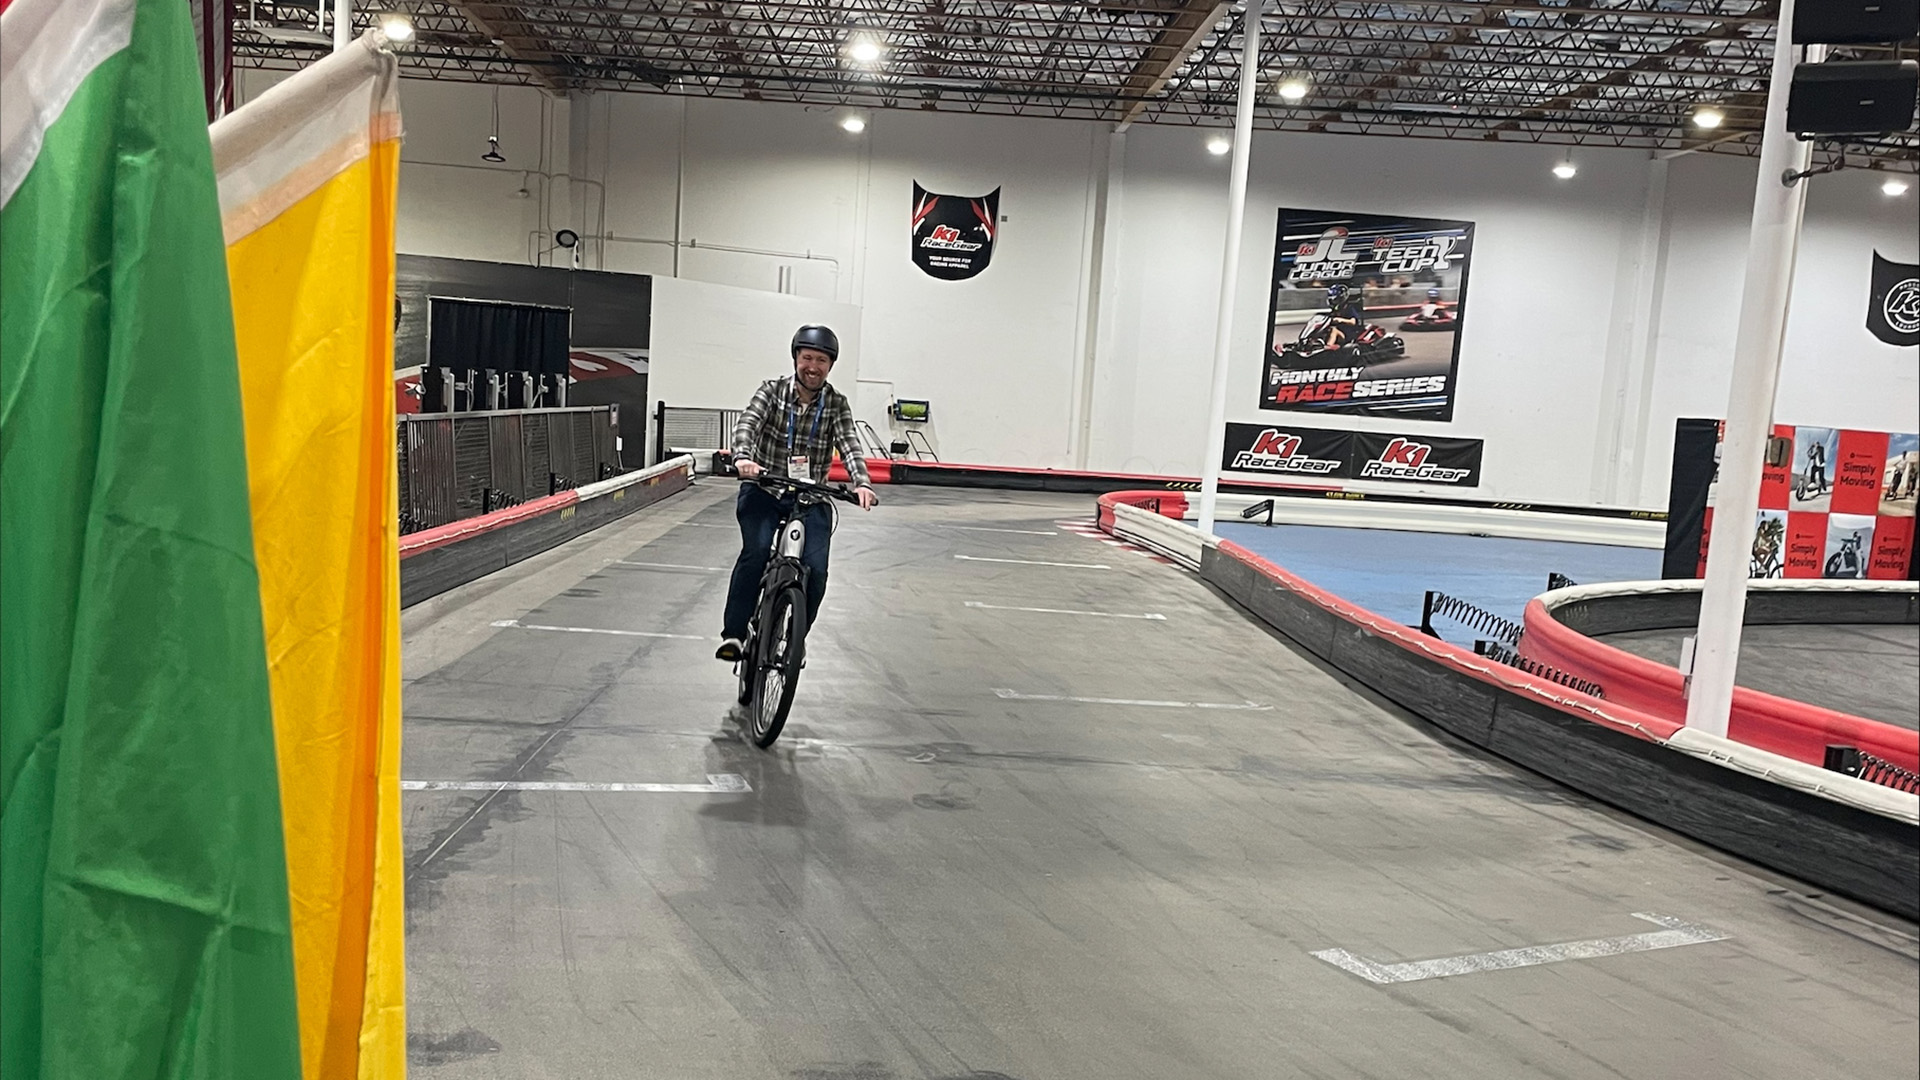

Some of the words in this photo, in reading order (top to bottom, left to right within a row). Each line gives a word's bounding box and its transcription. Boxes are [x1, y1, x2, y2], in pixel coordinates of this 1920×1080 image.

[932, 226, 960, 243] K1
[921, 238, 982, 251] RaceGear
[1373, 245, 1440, 261] TEEN
[1293, 260, 1356, 273] JUNIOR
[1382, 258, 1436, 273] CUP
[1290, 270, 1354, 281] LEAGUE
[1271, 367, 1364, 386] MONTHLY
[1275, 382, 1353, 404] RACE
[1352, 375, 1447, 398] SERIES
[1251, 430, 1300, 458] K1
[1381, 440, 1430, 467] K1
[1233, 453, 1340, 473] RaceGear
[1843, 462, 1876, 476] Simply
[1362, 462, 1470, 482] RaceGear
[1762, 471, 1785, 483] oving
[1840, 475, 1876, 489] Moving
[1790, 543, 1817, 556] Simply
[1878, 546, 1905, 557] Simply
[1788, 557, 1817, 569] Moving
[1874, 558, 1905, 571] Moving
